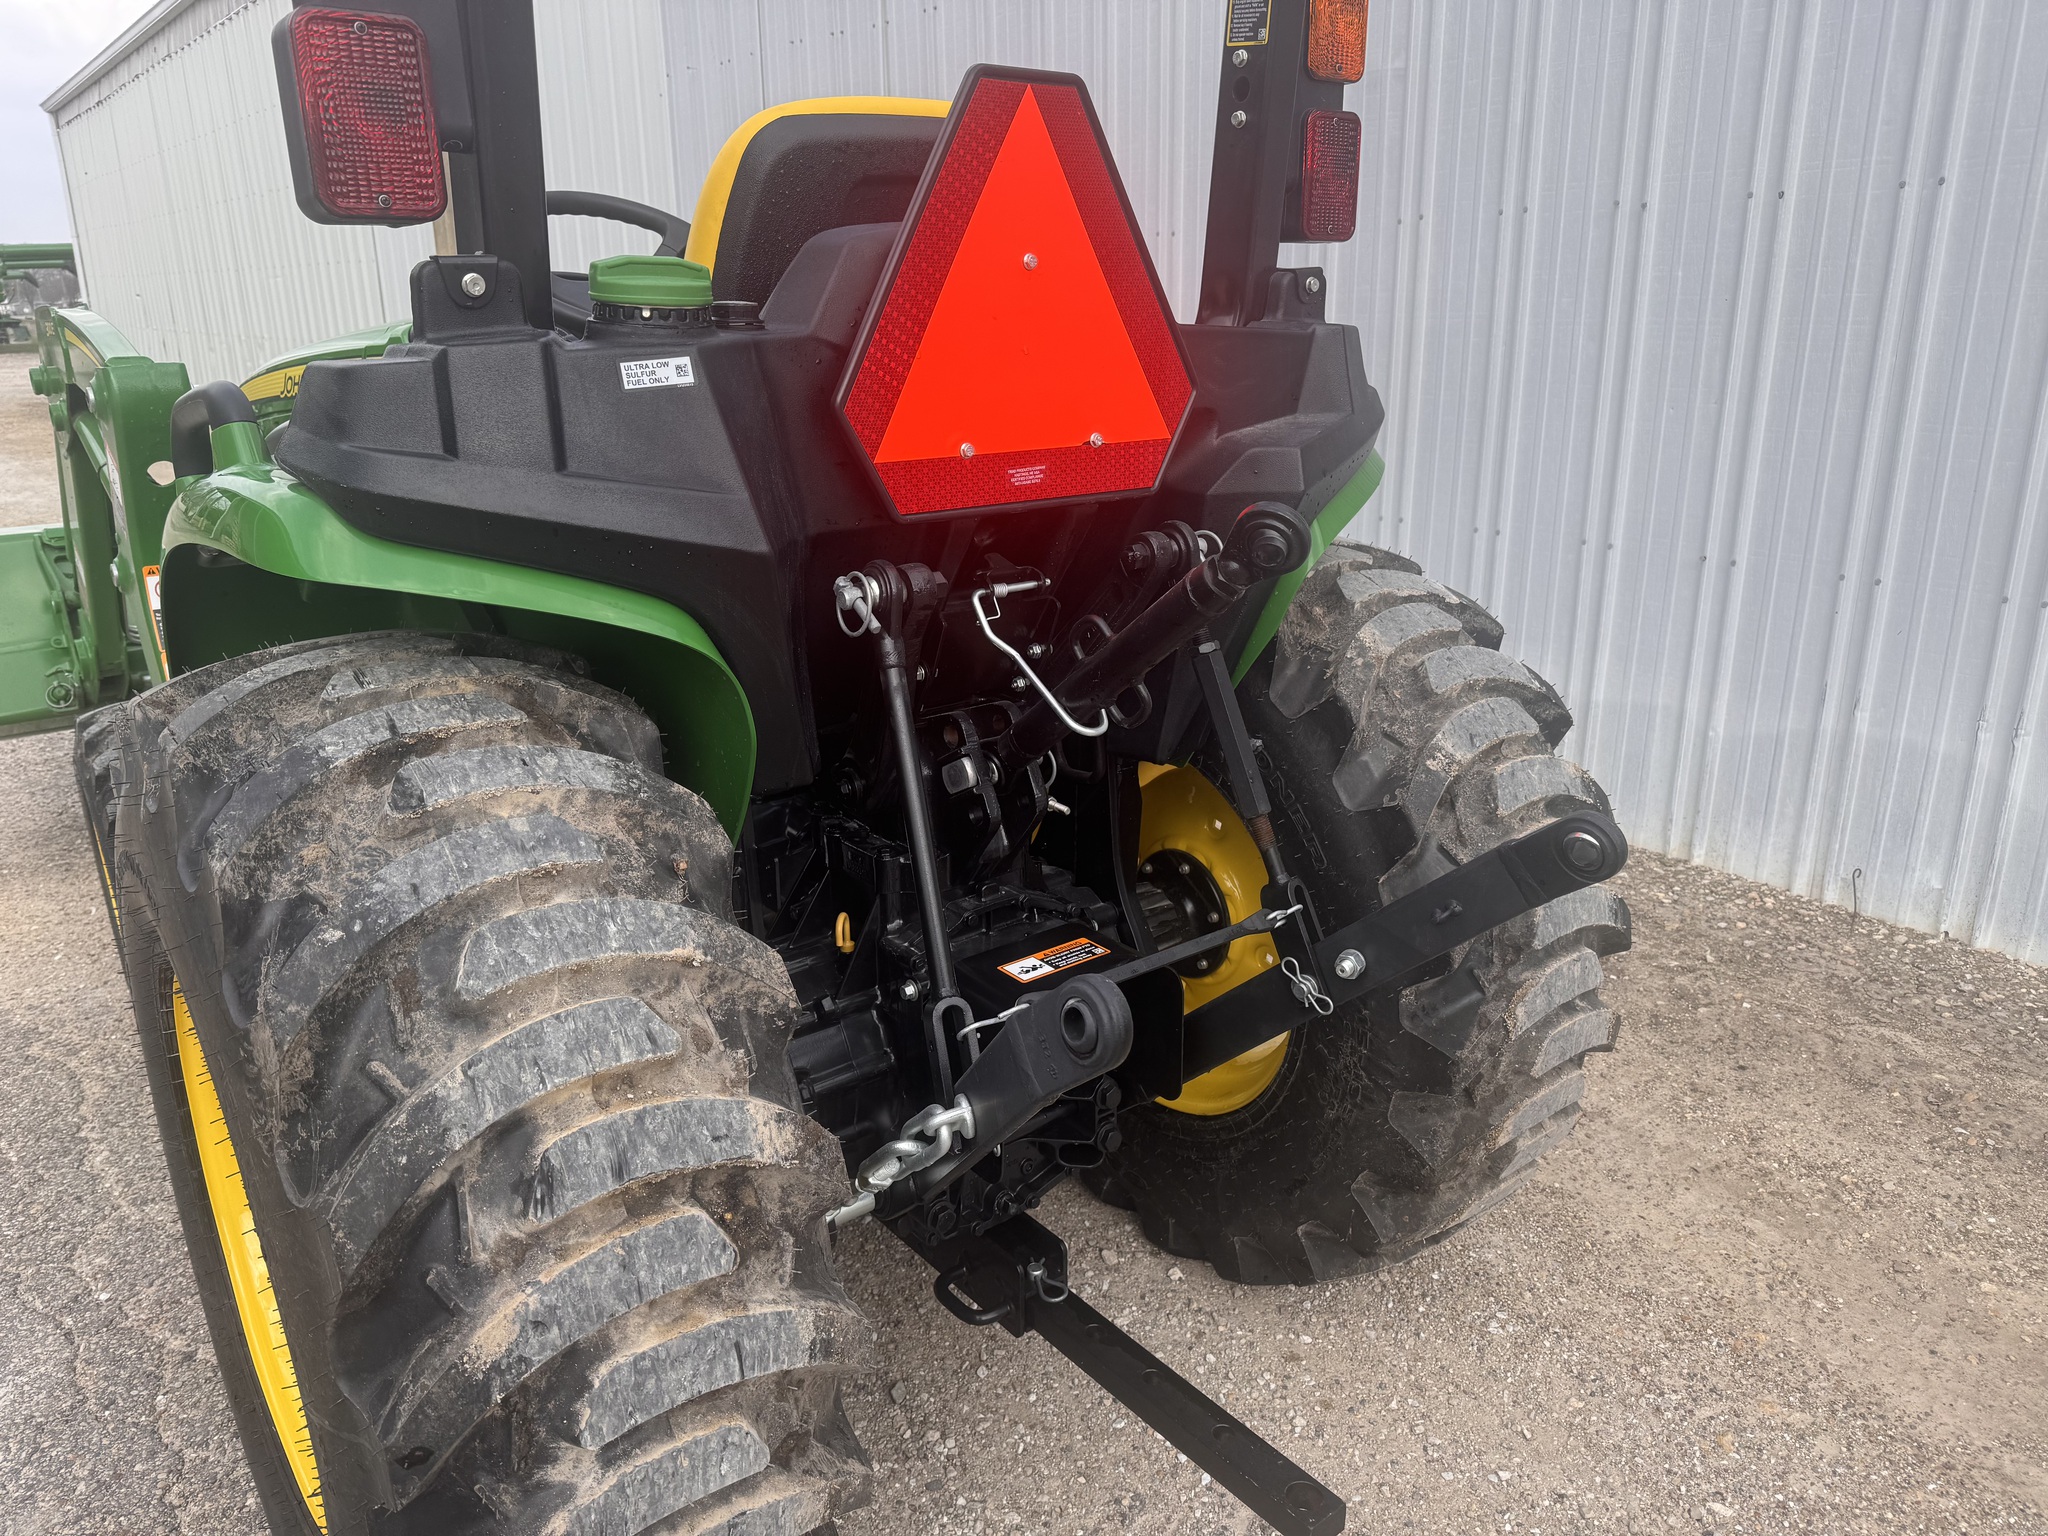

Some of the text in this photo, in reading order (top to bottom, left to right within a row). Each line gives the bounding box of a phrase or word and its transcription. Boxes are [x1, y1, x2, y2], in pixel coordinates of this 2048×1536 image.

[624, 361, 670, 372] ULTRA LOW
[625, 370, 657, 379] SULFUR
[648, 376, 670, 384] ONLY
[280, 372, 300, 396] JOH
[1050, 942, 1082, 954] WARNING
